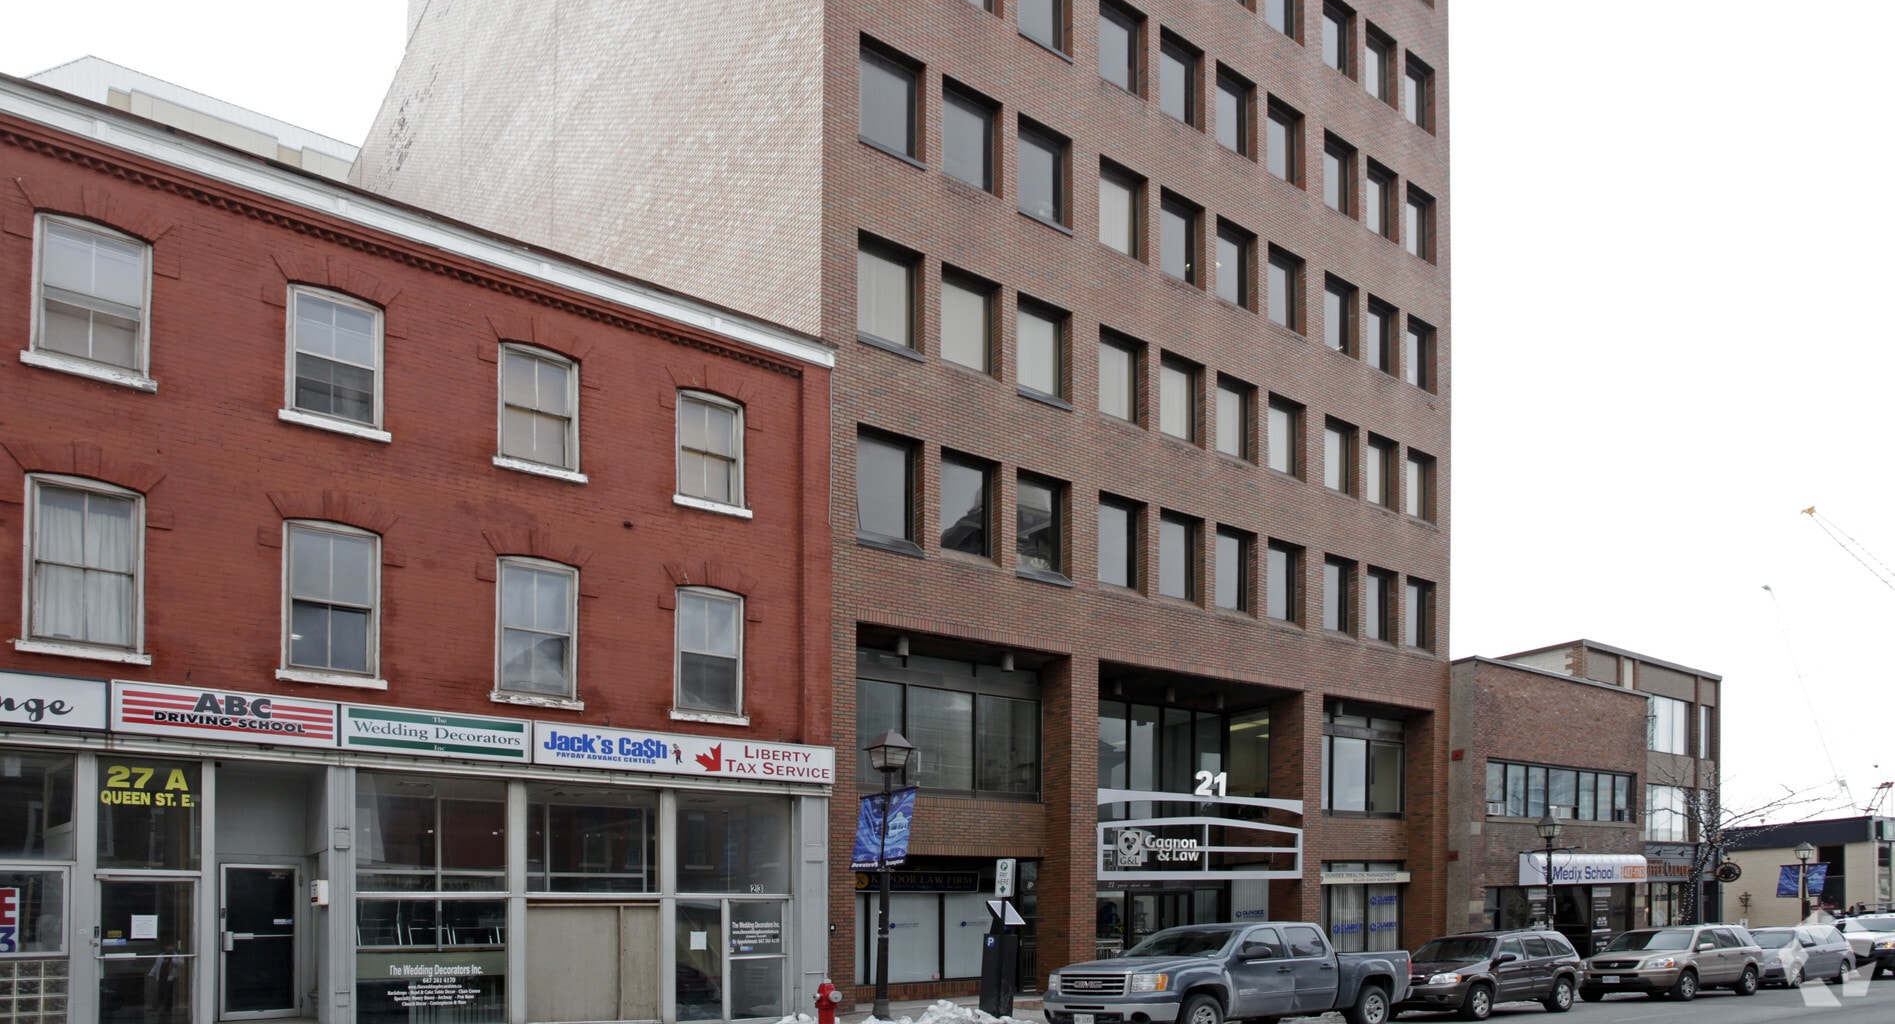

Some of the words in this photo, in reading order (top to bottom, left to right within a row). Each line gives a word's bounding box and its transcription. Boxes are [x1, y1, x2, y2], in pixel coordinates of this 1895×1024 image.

[193, 693, 272, 719] ABC
[154, 711, 232, 727] DRIVING
[238, 719, 305, 734] SCHOOL
[432, 716, 447, 724] The
[353, 720, 428, 741] Wedding
[435, 727, 521, 745] Decorators
[544, 731, 613, 754] Jack's
[619, 737, 667, 759] Ca$h
[556, 751, 585, 759] PAYDAY
[587, 754, 622, 762] ADVANCE
[624, 757, 656, 765] CENTERS
[744, 745, 811, 763] LIBERTY
[725, 759, 757, 774] TAX
[763, 762, 830, 779] SERVICE
[107, 765, 154, 789] 27
[165, 769, 189, 791] A
[1194, 770, 1228, 797] 21
[100, 790, 151, 805] QUEEN
[155, 792, 176, 806] ST.
[181, 794, 195, 807] E.
[1145, 835, 1197, 852] Gagnon
[1120, 856, 1139, 865] G&L
[1157, 850, 1170, 862] &
[1172, 850, 1200, 862] Law
[920, 875, 945, 884] LAW
[947, 875, 972, 885] FIRM
[1553, 866, 1583, 880] Medix
[1584, 865, 1614, 880] School
[750, 884, 763, 894] 23
[389, 964, 402, 976] The
[403, 964, 433, 977] Wedding
[434, 964, 470, 975] Decorators
[471, 963, 484, 975] Inc.
[1073, 980, 1102, 988] GMC
